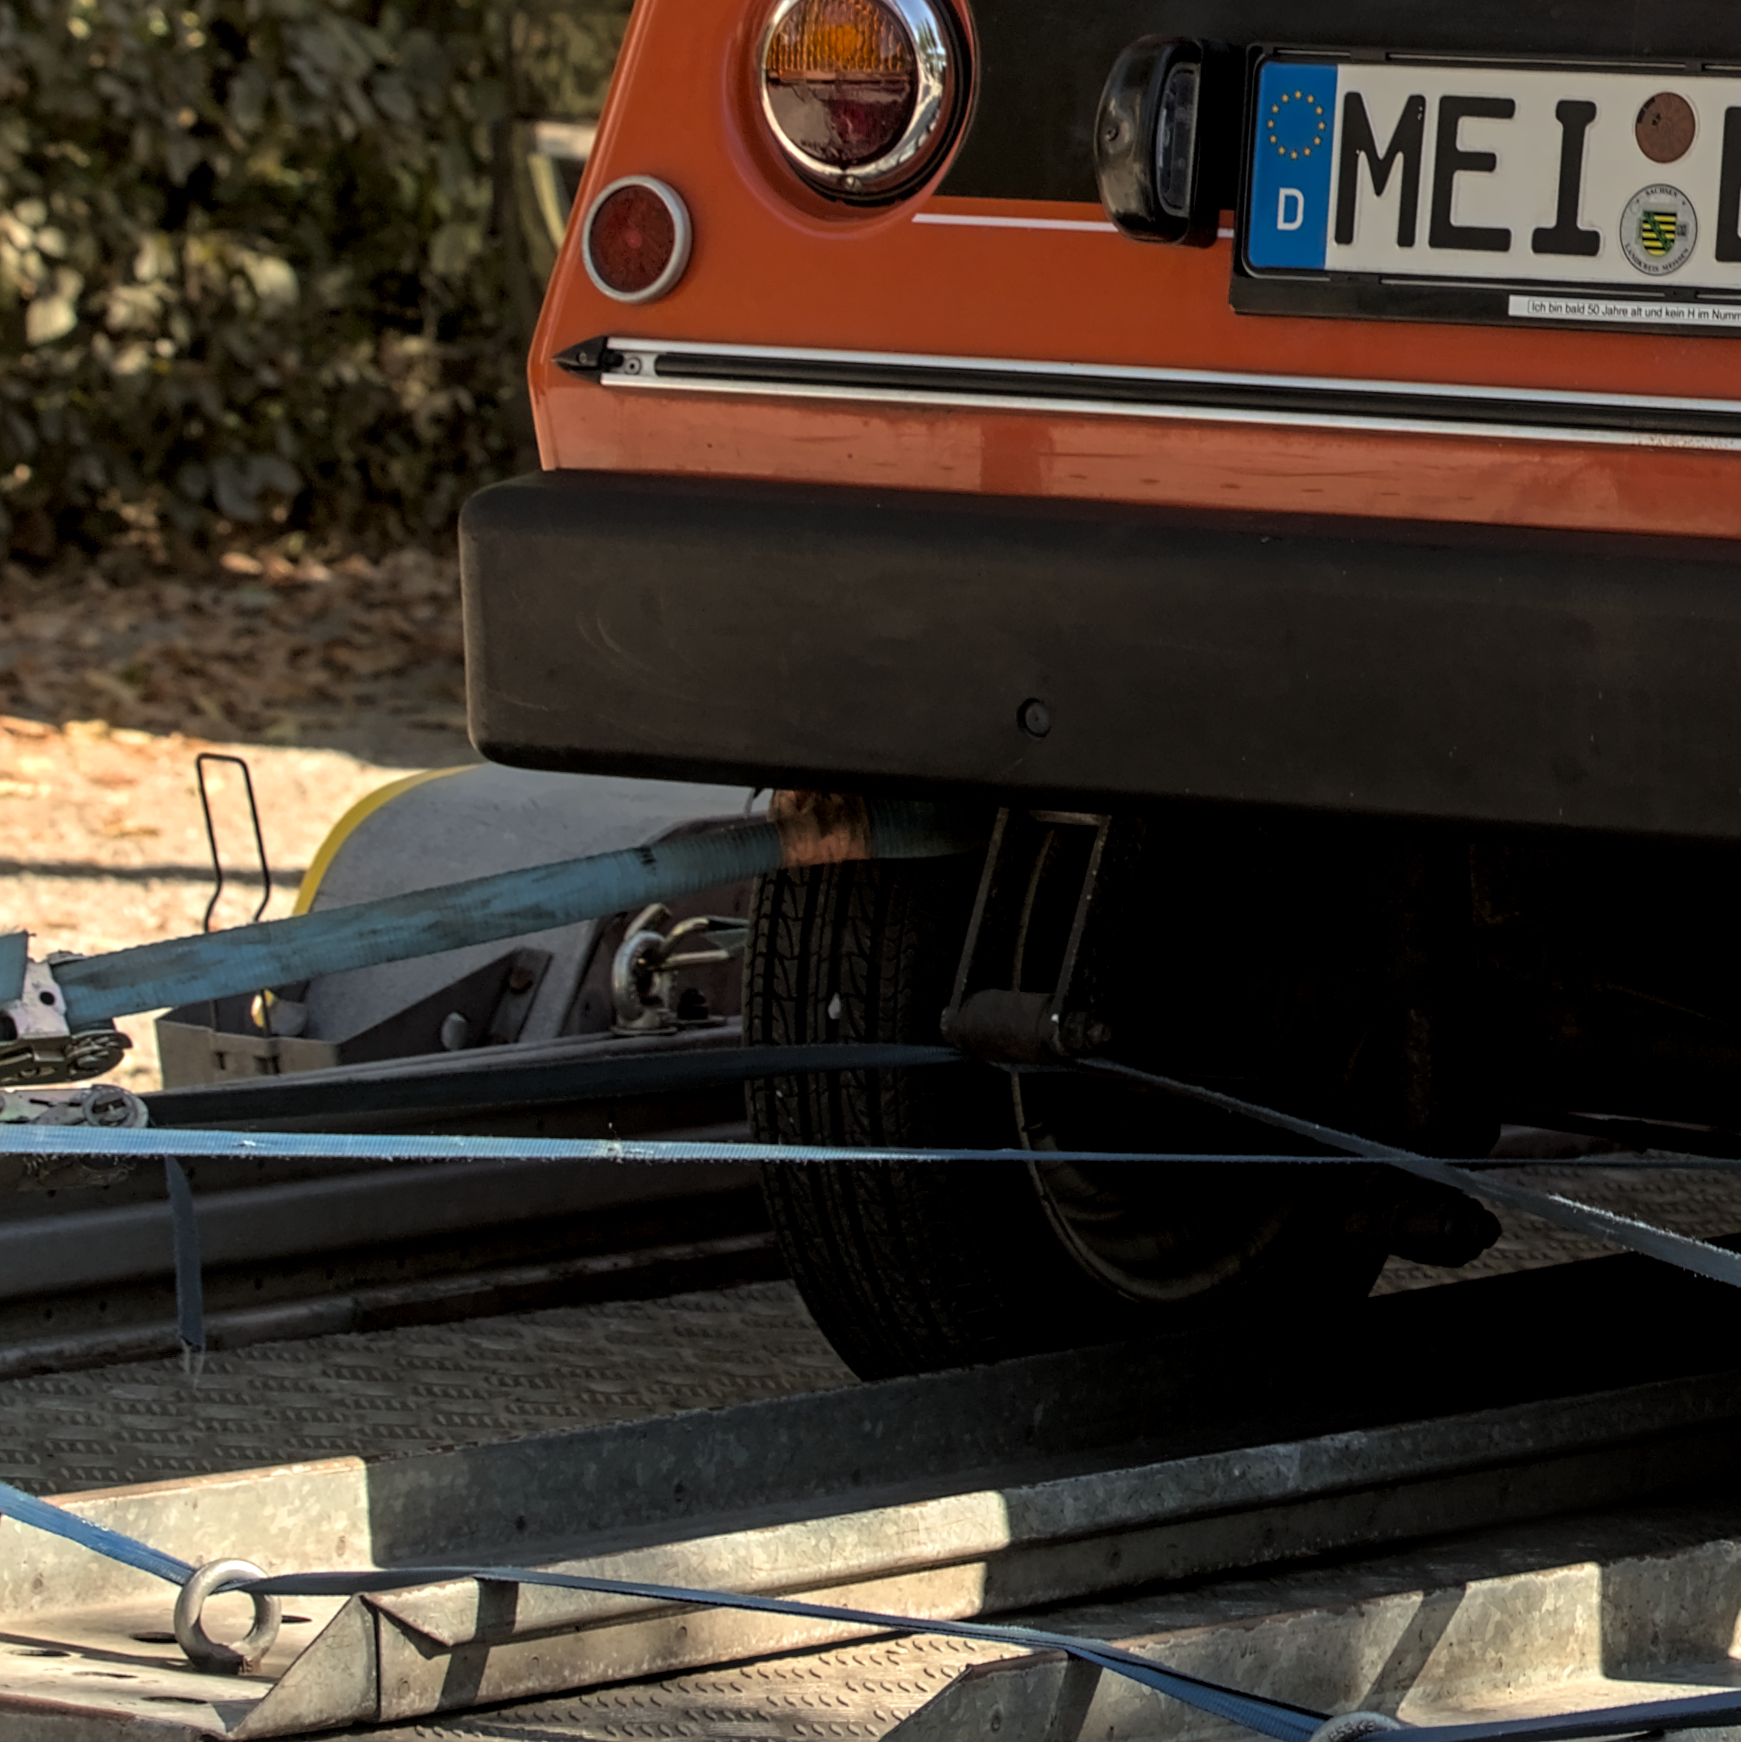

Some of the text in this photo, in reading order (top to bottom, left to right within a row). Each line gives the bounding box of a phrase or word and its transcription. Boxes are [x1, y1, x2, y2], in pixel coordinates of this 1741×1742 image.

[1276, 187, 1305, 230] D
[1334, 91, 1601, 256] MEI
[1532, 301, 1546, 313] Ich
[1548, 302, 1563, 313] bin
[1565, 303, 1585, 315] bald
[1587, 304, 1600, 315] 50
[1601, 305, 1628, 317] Jahre
[1630, 306, 1643, 317] alt
[1644, 307, 1663, 318] und
[1665, 307, 1685, 318] kein
[1687, 308, 1696, 318] H
[1698, 308, 1709, 319] im
